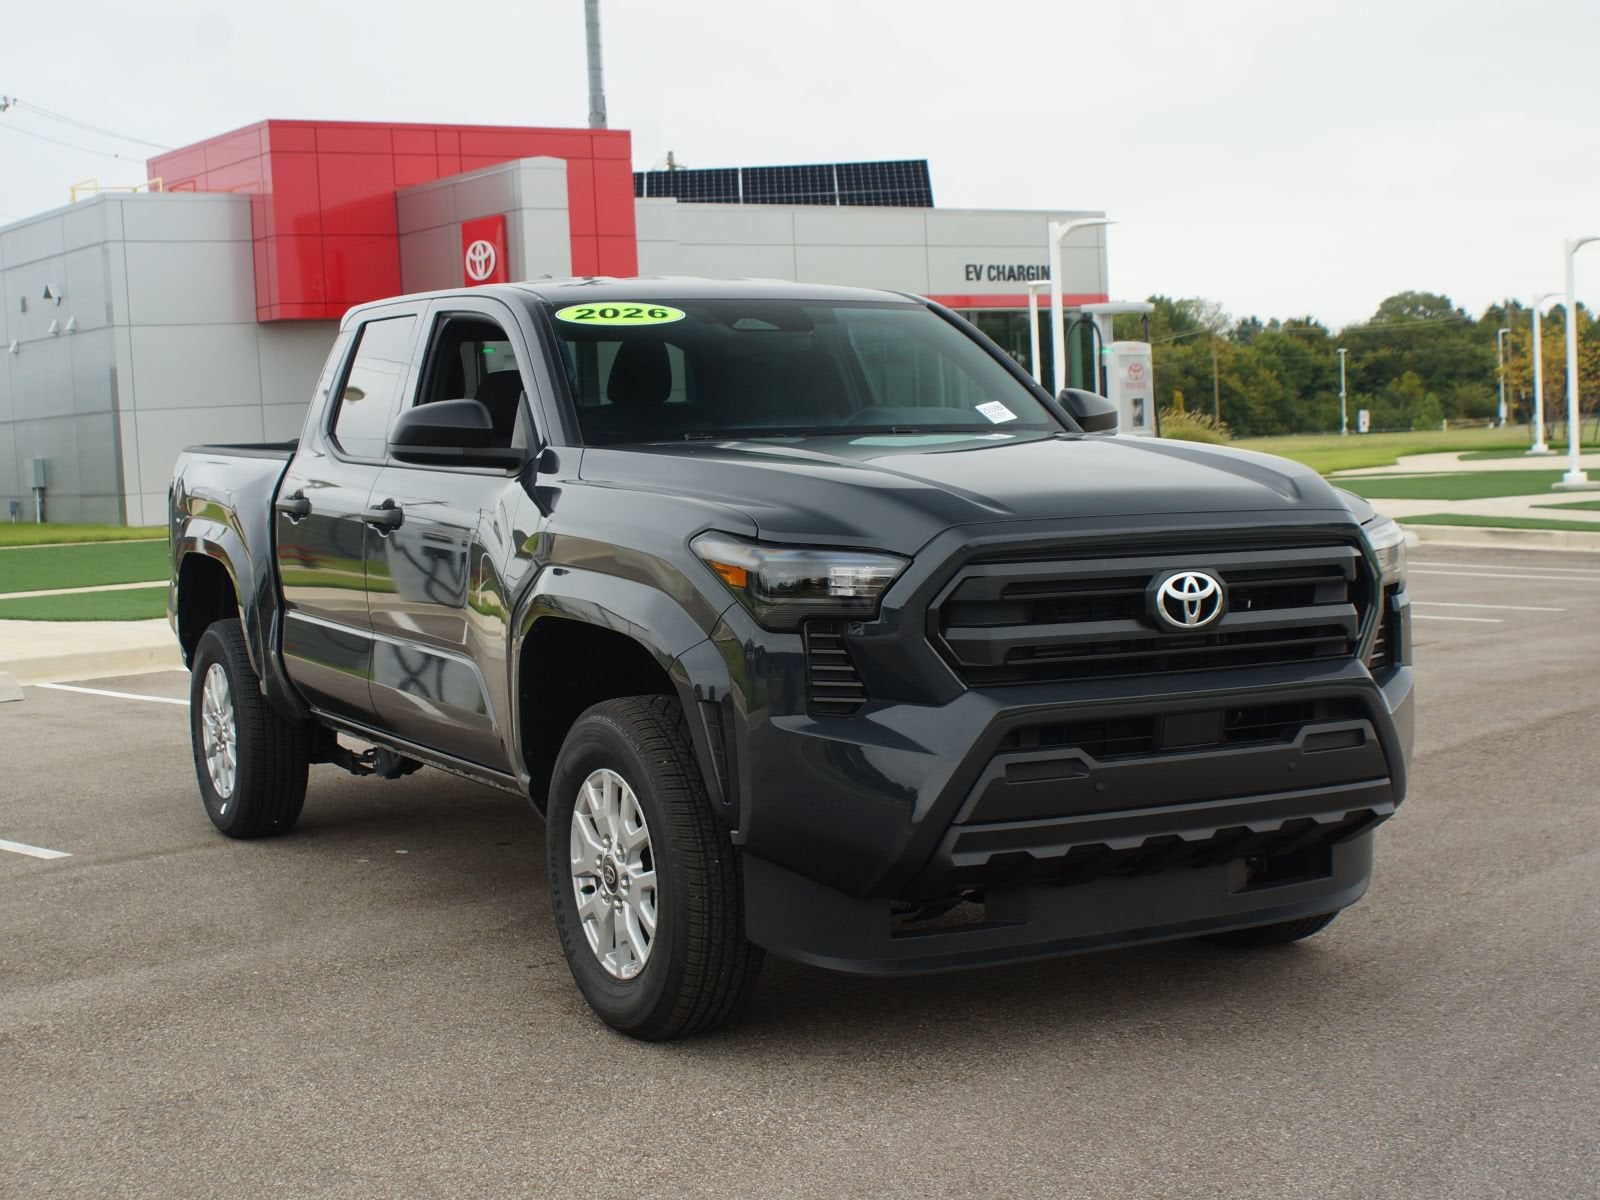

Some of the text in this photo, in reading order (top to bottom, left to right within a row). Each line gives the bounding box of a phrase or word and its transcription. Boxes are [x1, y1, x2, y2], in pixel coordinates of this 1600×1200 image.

[965, 264, 1051, 281] EV CHARGIN
[574, 308, 668, 319] 2026
